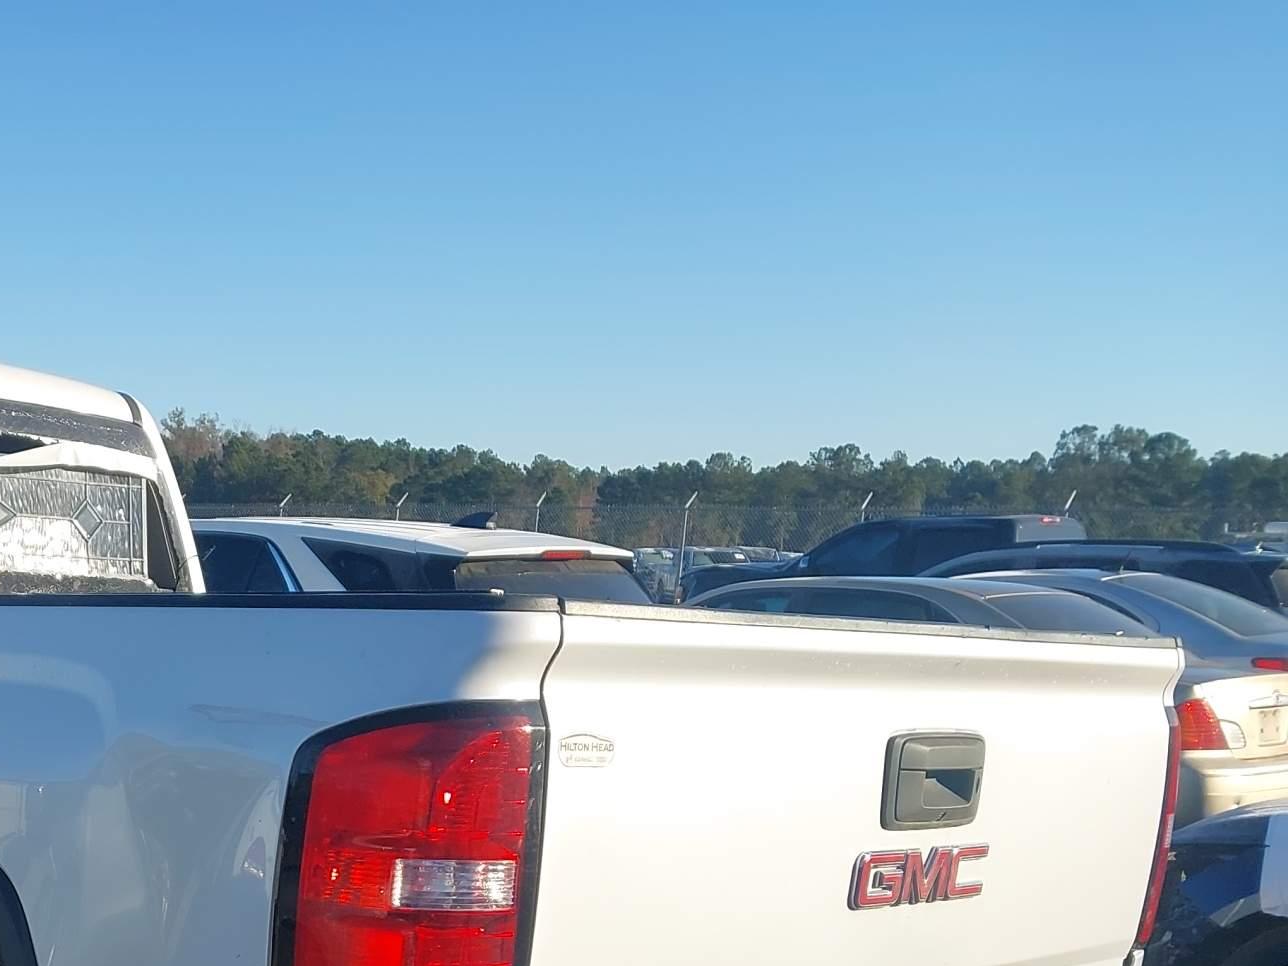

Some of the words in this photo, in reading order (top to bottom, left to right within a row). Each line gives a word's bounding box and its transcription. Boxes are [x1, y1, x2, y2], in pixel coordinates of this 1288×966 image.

[559, 740, 590, 752] HILTON
[591, 742, 615, 752] HEAD
[847, 843, 990, 911] GMC
